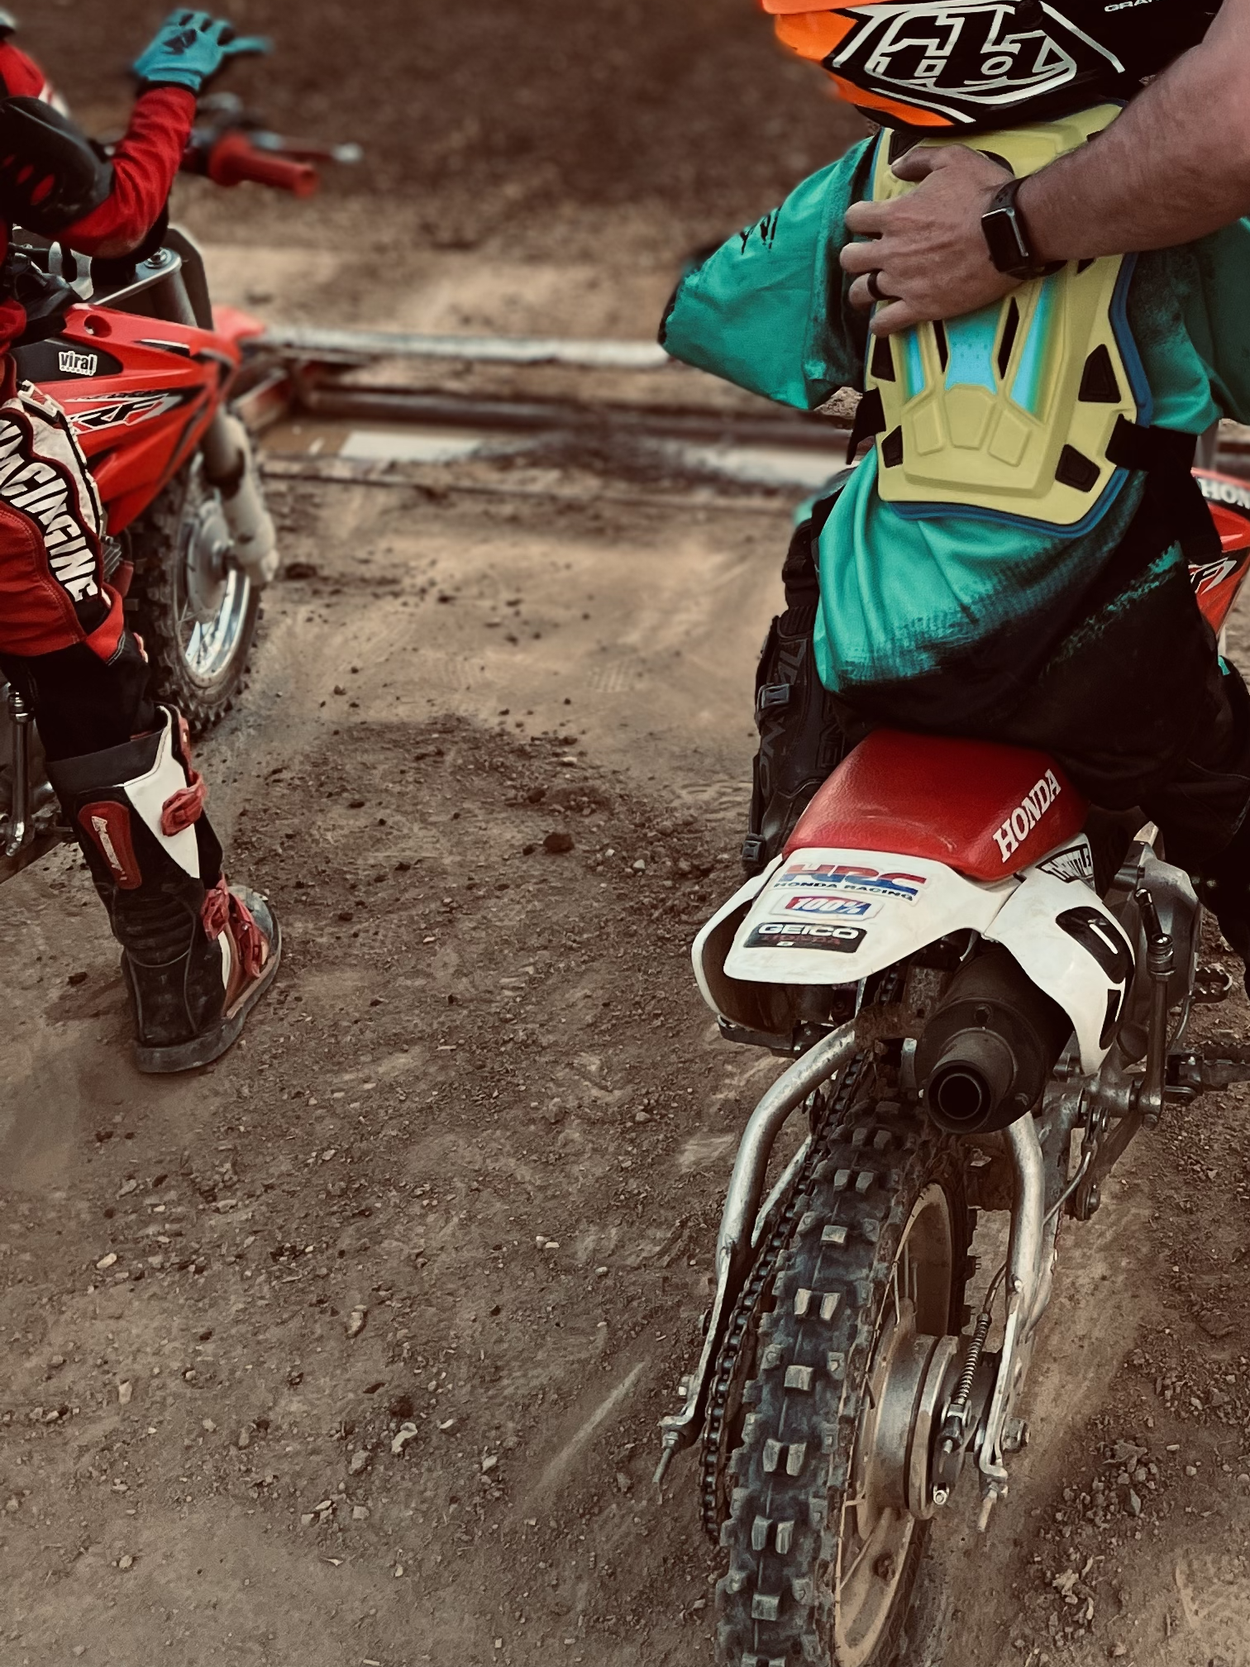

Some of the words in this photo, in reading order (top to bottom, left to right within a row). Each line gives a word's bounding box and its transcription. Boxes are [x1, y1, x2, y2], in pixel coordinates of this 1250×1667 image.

[59, 351, 97, 370] viral
[992, 768, 1062, 864] HONDA
[777, 864, 927, 896] HRC
[844, 885, 913, 901] RACING
[793, 897, 867, 915] 100%
[758, 923, 859, 940] GEICO
